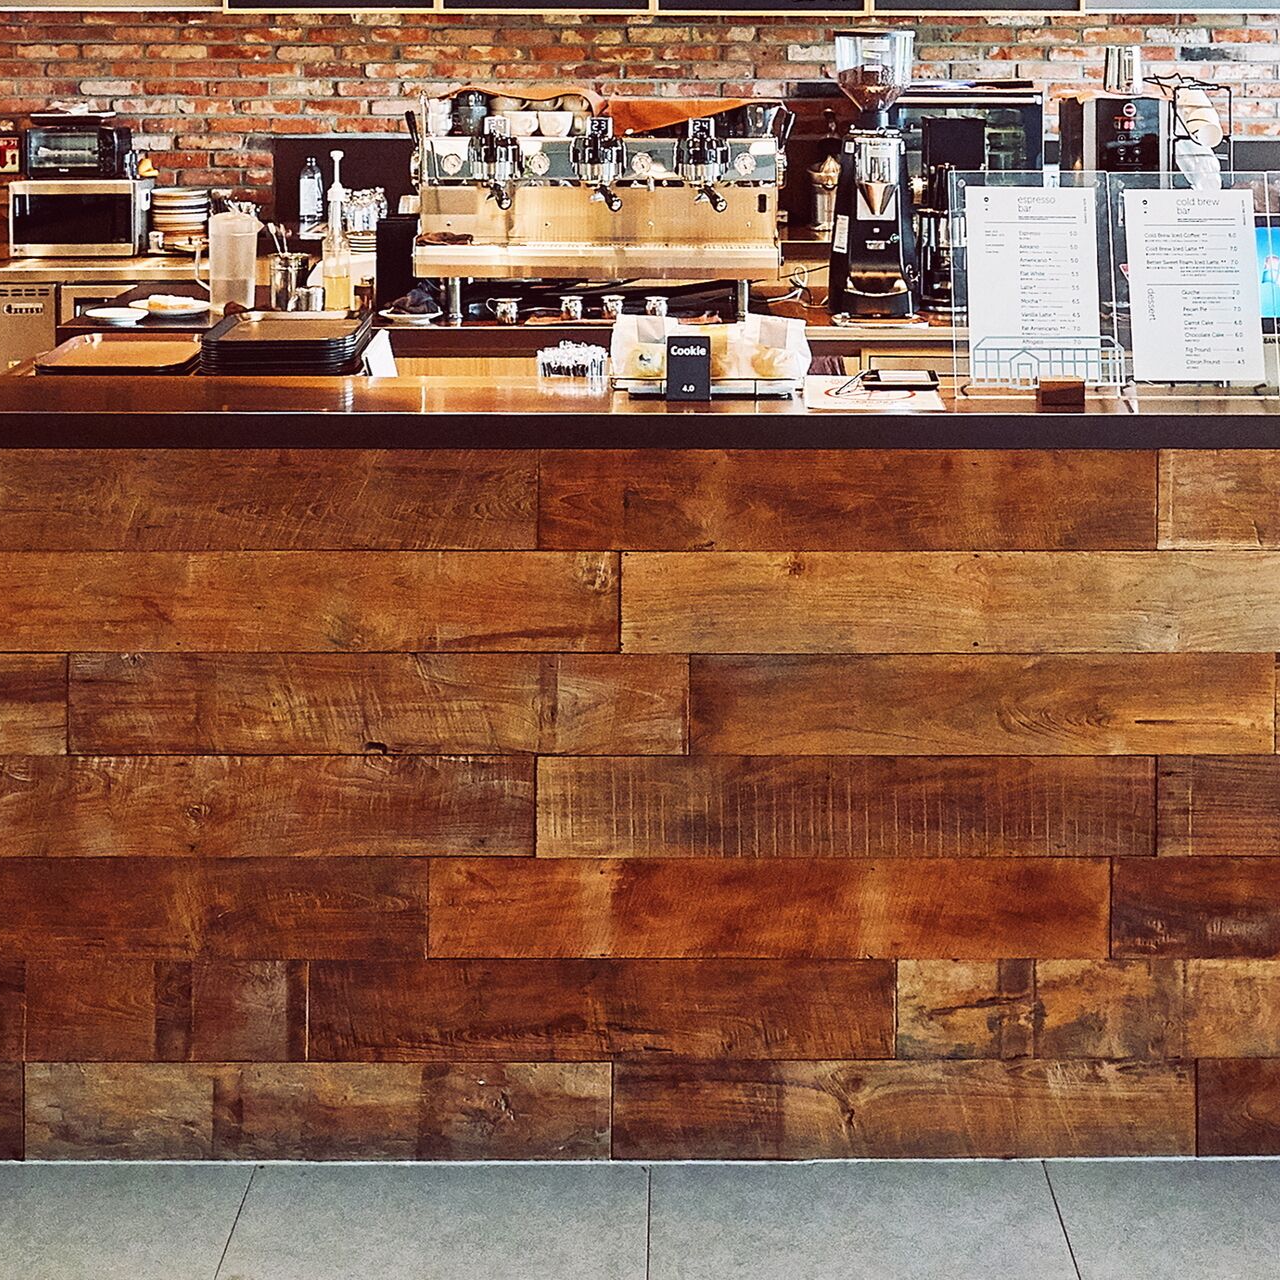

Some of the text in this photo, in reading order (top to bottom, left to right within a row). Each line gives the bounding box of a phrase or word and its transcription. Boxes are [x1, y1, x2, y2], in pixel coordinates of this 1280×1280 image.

[592, 119, 607, 131] 23
[694, 119, 709, 131] 24
[1018, 196, 1056, 205] espresso
[1176, 198, 1220, 206] cold brew
[1176, 207, 1190, 215] bar
[1147, 288, 1156, 320] dessert
[670, 345, 707, 356] Cookie
[682, 384, 695, 392] 4.0
